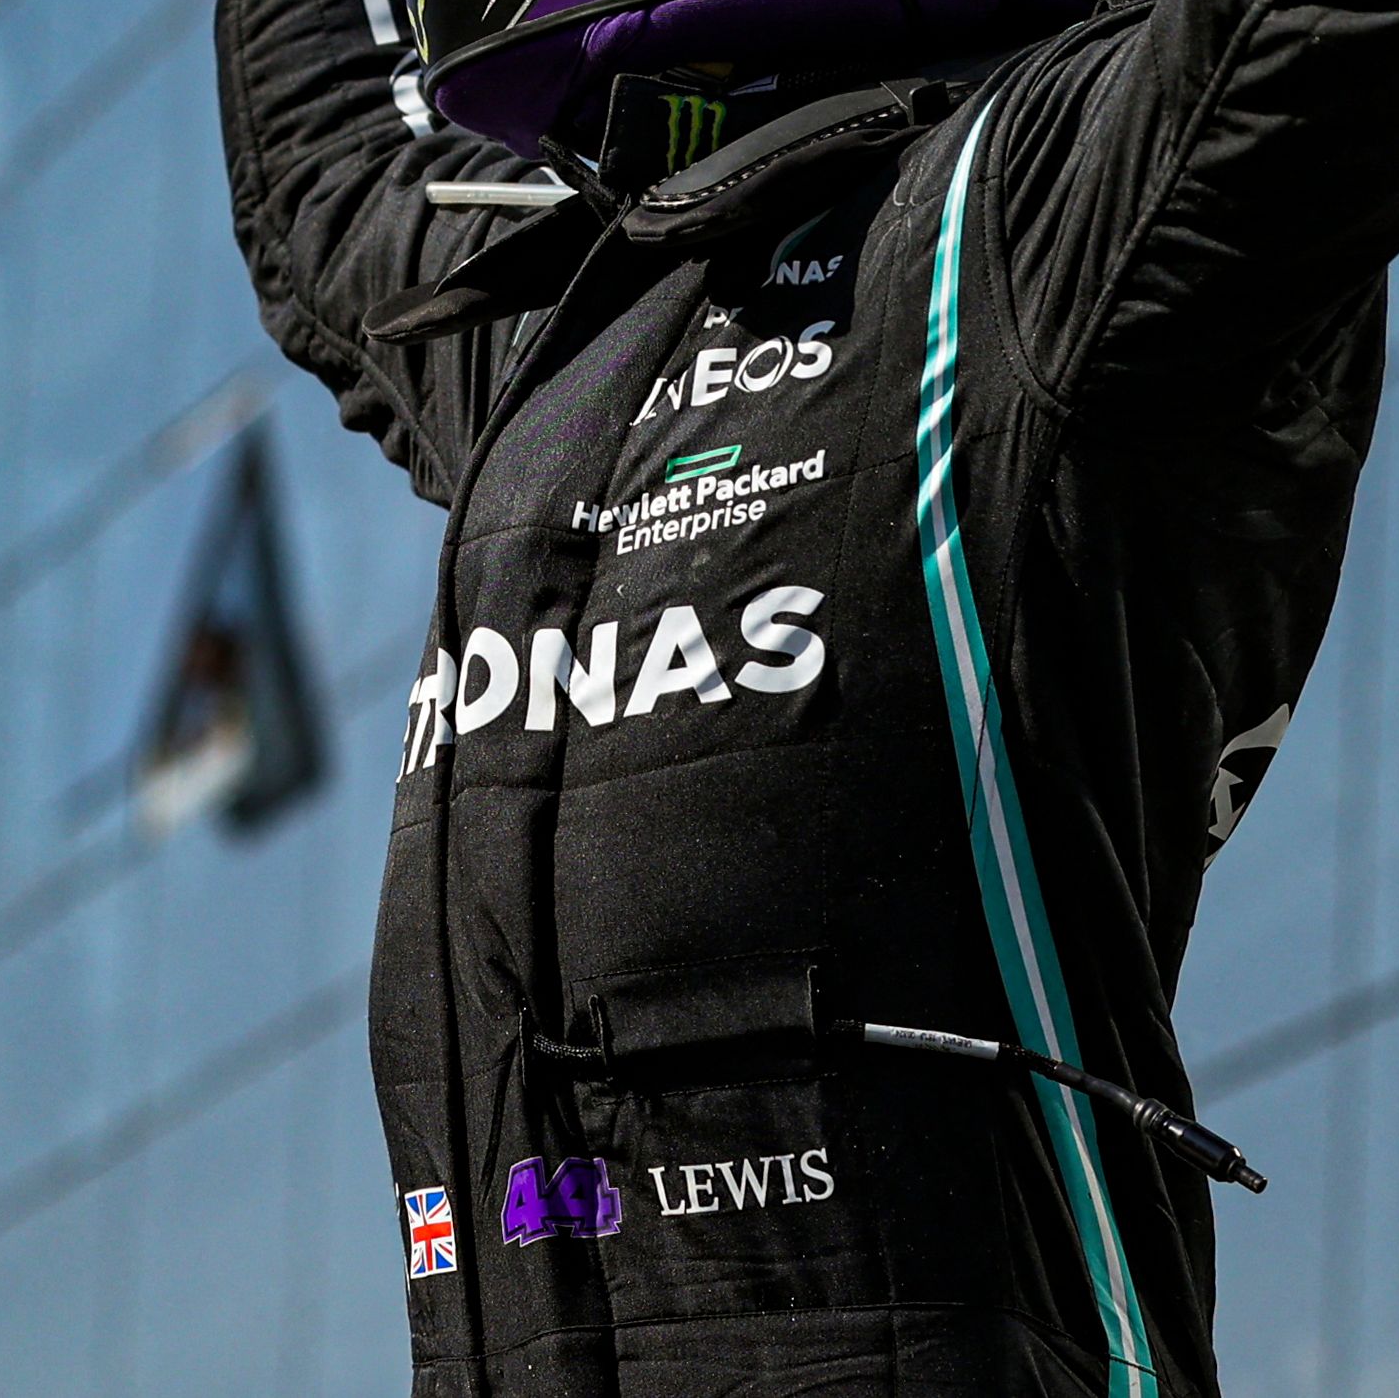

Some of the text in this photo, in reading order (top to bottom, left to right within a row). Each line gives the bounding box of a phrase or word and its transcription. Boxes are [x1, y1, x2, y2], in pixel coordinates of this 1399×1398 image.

[571, 449, 826, 533] Hewlett Packard
[616, 498, 767, 556] Enterprise
[501, 1147, 836, 1247] 44 LEWIS
